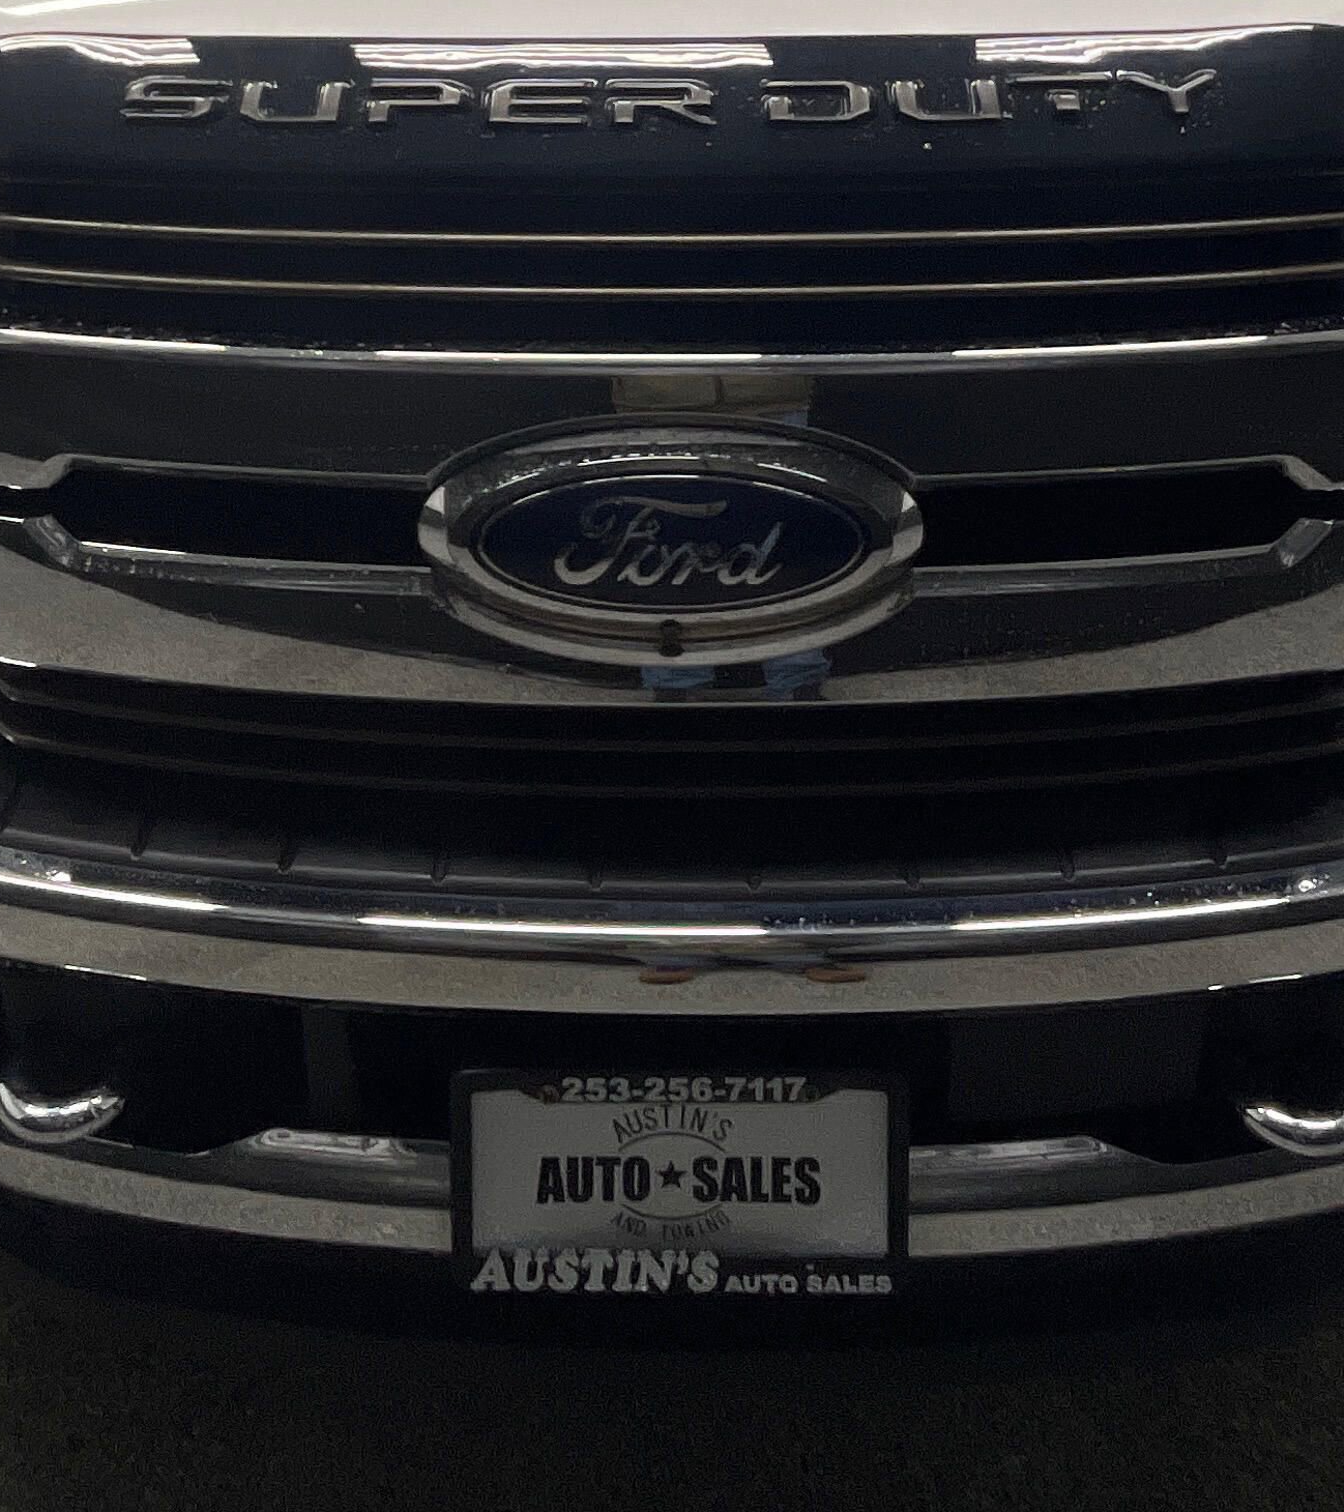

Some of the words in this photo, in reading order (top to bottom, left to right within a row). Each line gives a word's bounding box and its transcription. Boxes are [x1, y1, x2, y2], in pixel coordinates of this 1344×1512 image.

[120, 72, 720, 126] SUPER
[761, 66, 1217, 128] DUTY
[553, 496, 784, 586] Ford
[562, 1077, 807, 1103] 253-256-7117
[612, 1103, 733, 1143] AUSTIN'S
[536, 1156, 651, 1204] AUTO
[693, 1156, 821, 1205] SALES
[470, 1246, 720, 1294] AUSTIN'S
[725, 1275, 798, 1295] AUTO
[805, 1275, 893, 1295] SALES
